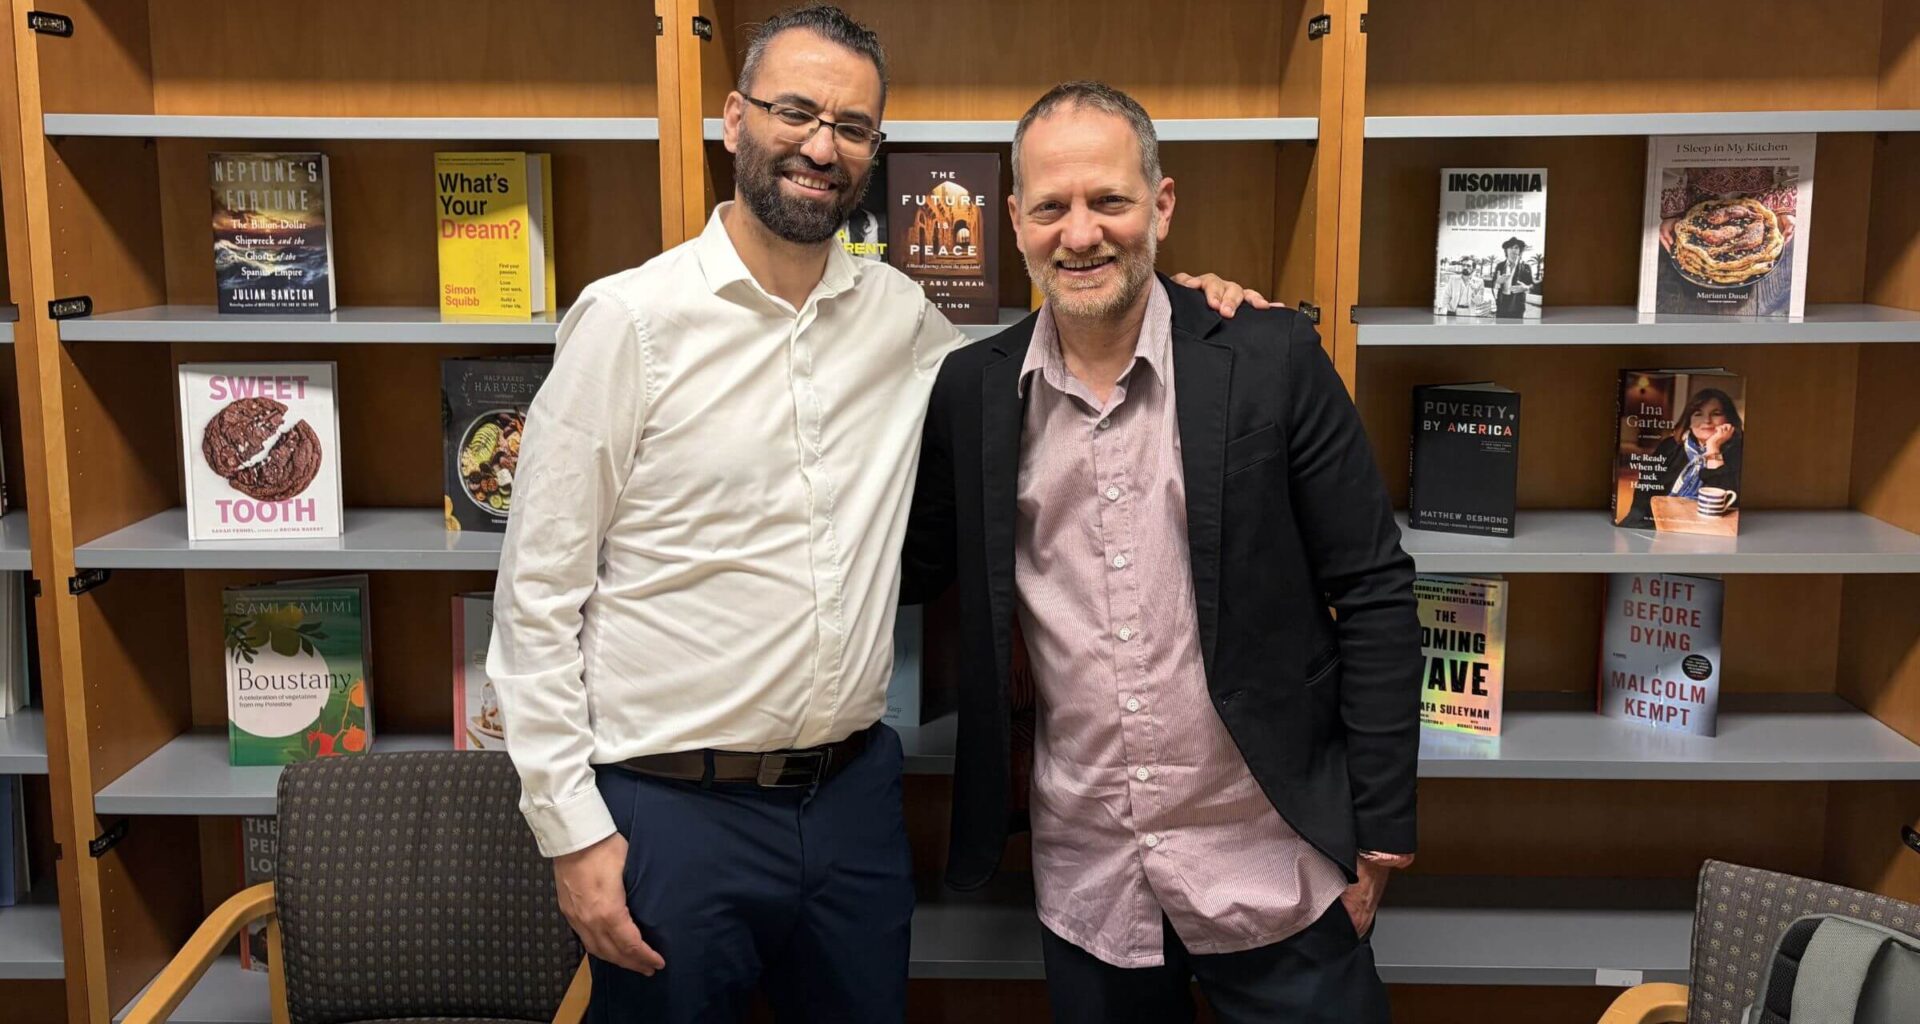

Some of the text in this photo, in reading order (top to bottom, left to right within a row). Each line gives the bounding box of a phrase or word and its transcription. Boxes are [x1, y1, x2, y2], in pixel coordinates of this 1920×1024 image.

[1683, 144, 1711, 154] Sleep
[1714, 144, 1724, 152] in
[1727, 144, 1744, 154] My
[1747, 143, 1788, 152] Kitchen
[215, 161, 317, 183] NEPTUNE'S
[439, 173, 509, 193] What's
[1448, 174, 1542, 192] INSOMNIA
[227, 190, 308, 211] FORTUNE
[440, 196, 487, 216] Your
[902, 195, 985, 206] FUTURE
[1466, 194, 1523, 210] ROBBIE
[232, 220, 306, 229] The Billion-Dollar
[1447, 212, 1541, 227] ROBERTSON
[441, 219, 521, 240] Dream?
[235, 235, 274, 249] Shipwreck
[294, 237, 305, 245] the
[285, 253, 296, 261] the
[910, 246, 977, 256] PEACE
[242, 267, 303, 280] Spanish Empire
[233, 289, 314, 300] JULIAN SANCTON
[445, 284, 476, 294] Simon
[446, 296, 480, 307] Squibb
[209, 376, 309, 400] SWEET
[475, 382, 534, 393] HARVEST
[1641, 403, 1663, 415] Ina
[1424, 420, 1512, 436] BY AMERICA
[1627, 416, 1675, 429] Garten
[1643, 454, 1667, 464] Ready
[1630, 463, 1668, 472] When the
[1638, 472, 1657, 481] Luck
[1631, 481, 1664, 492] Happens
[216, 499, 316, 524] TOOTH
[1420, 510, 1508, 524] MATTHEW DESMOND
[1632, 577, 1695, 602] A GIFT
[235, 601, 351, 615] SAMI TAMIMI
[1624, 600, 1701, 628] BEFORE
[1435, 609, 1456, 623] THE
[1421, 627, 1486, 655] OMING
[1631, 626, 1690, 652] DYING
[238, 668, 351, 693] Boustany
[1423, 656, 1489, 697] AVE
[1612, 671, 1706, 704] MALCOLM
[1440, 704, 1490, 719] SULEYMAN
[1625, 698, 1690, 726] KEMPT
[246, 818, 277, 835] THE
